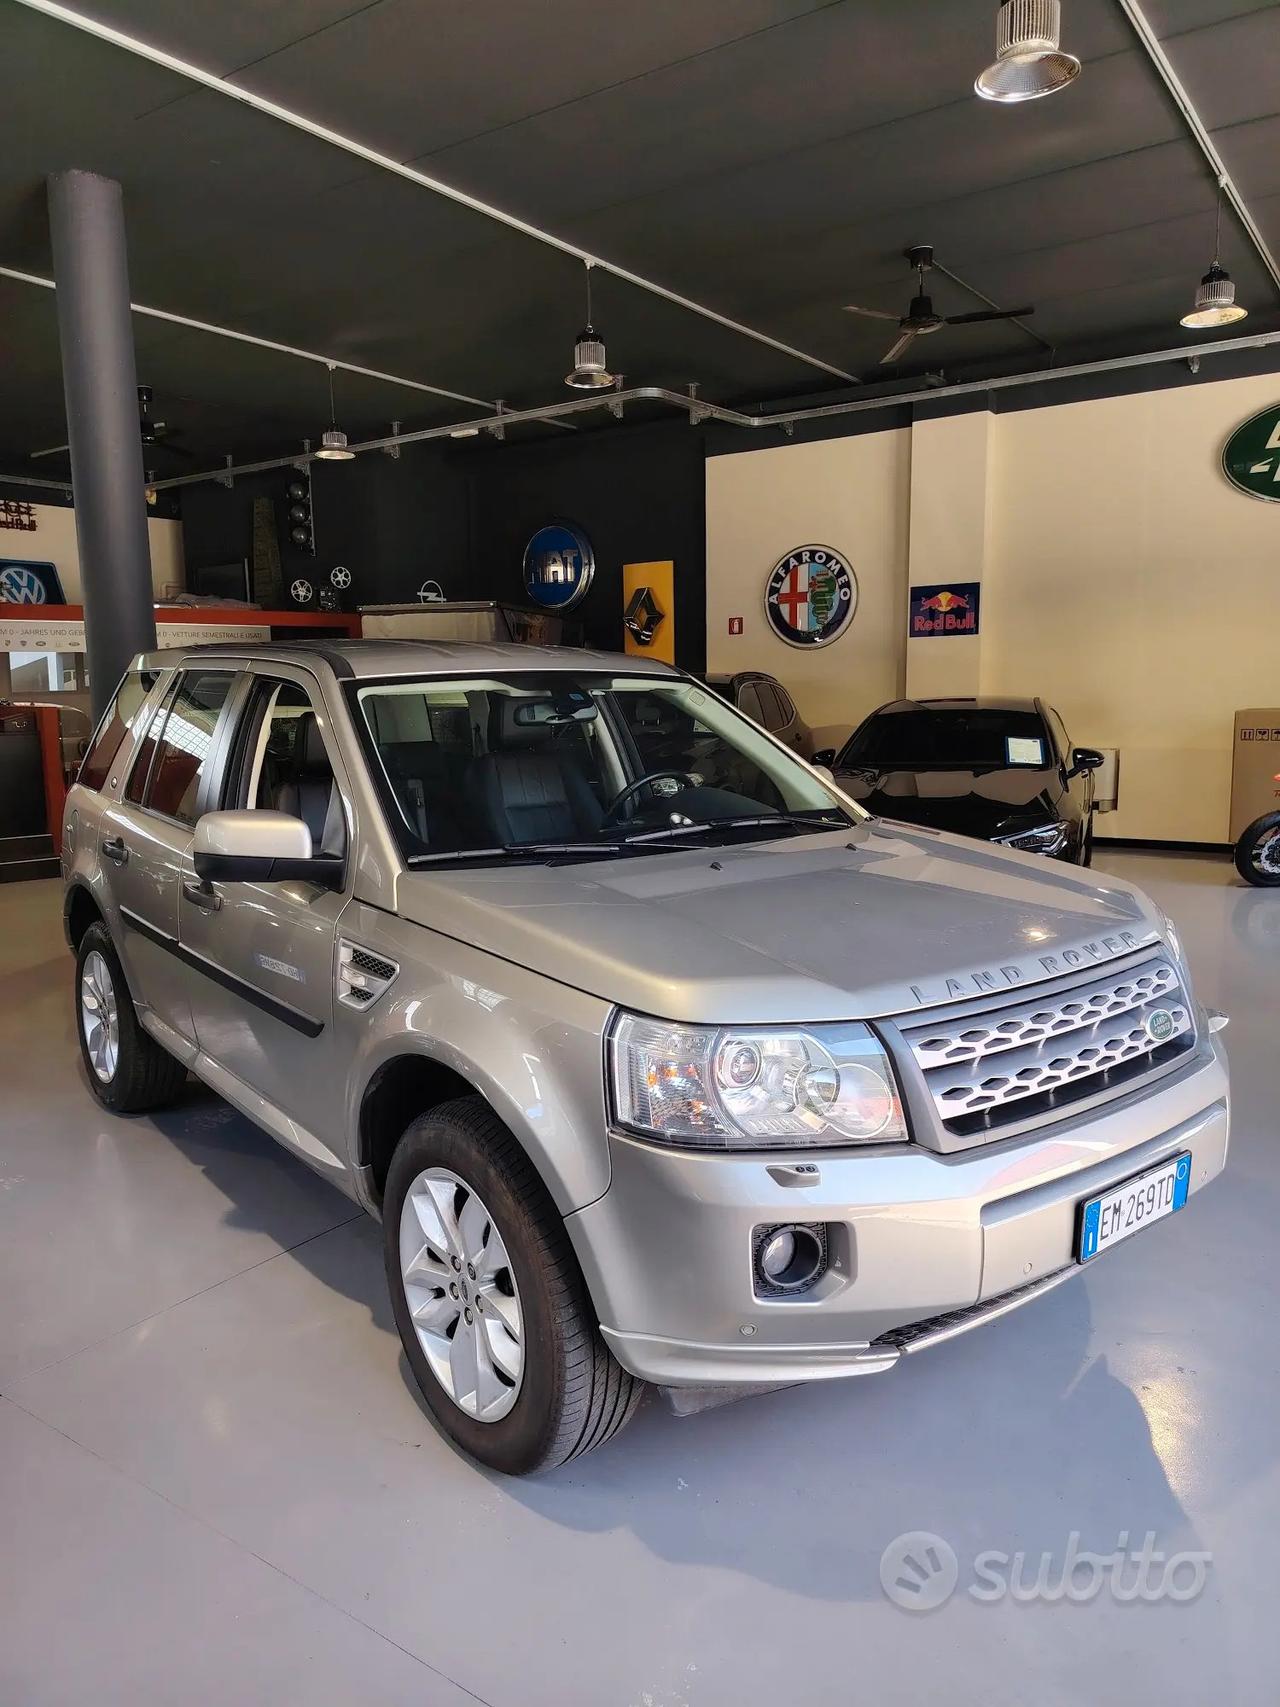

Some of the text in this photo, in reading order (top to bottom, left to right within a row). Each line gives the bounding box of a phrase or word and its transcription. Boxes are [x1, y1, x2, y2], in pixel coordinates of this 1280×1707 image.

[914, 612, 975, 631] Red Bull
[910, 931, 1140, 1004] LAND ROVER
[1100, 1200, 1122, 1241] EM
